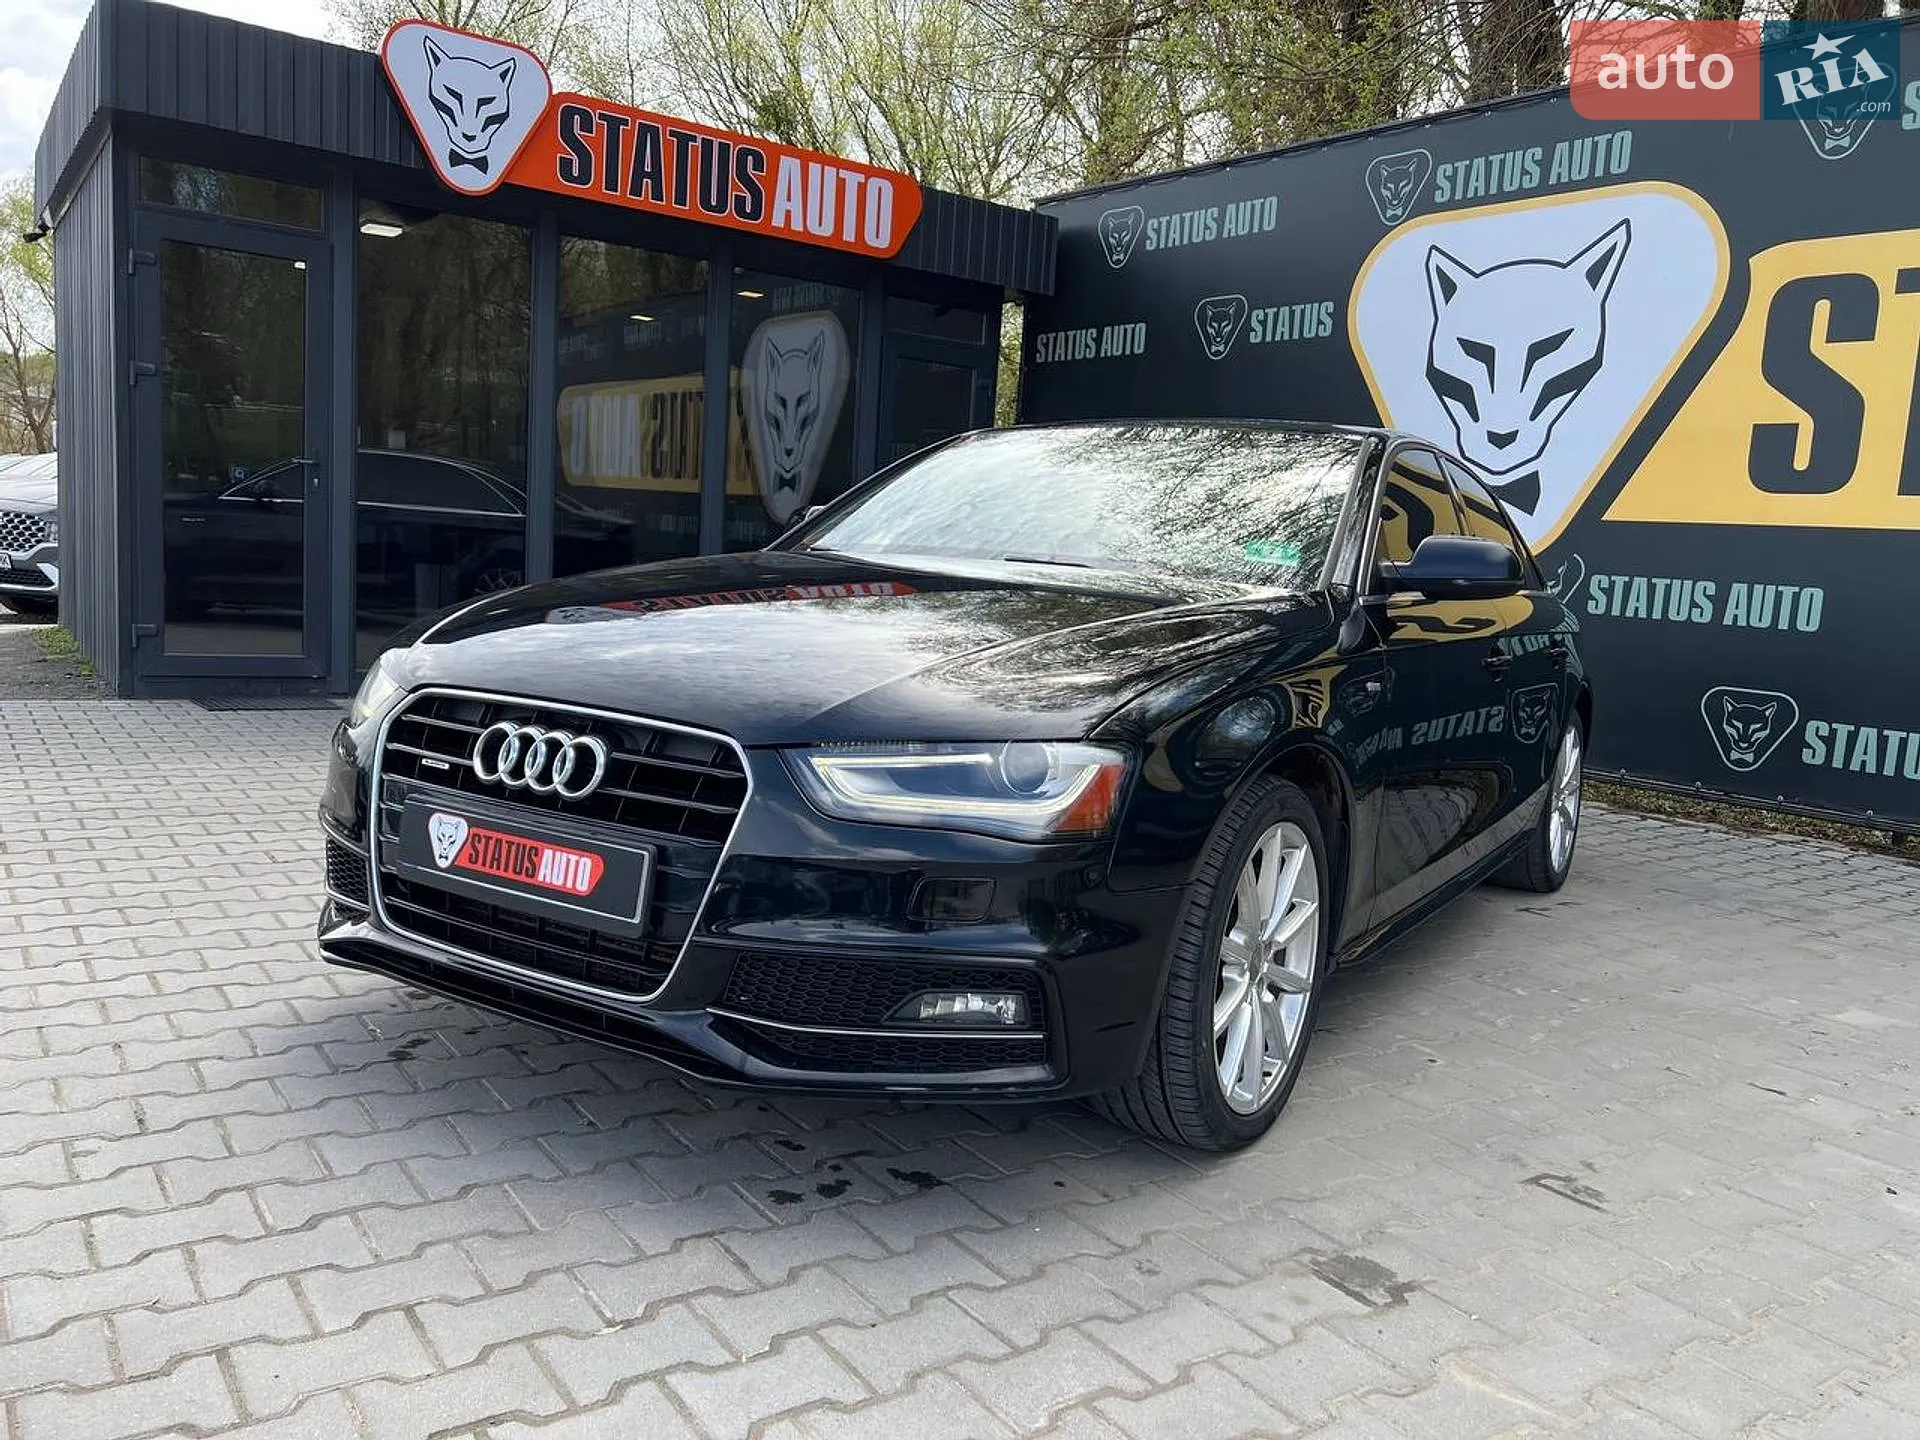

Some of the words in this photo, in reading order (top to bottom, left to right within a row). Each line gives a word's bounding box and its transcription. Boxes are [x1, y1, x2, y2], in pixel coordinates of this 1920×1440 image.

[557, 104, 767, 222] STATUS
[771, 155, 894, 249] AUTO
[1435, 146, 1541, 203] STATUS
[1548, 130, 1633, 185] AUTO
[1145, 206, 1219, 250] STATUS
[1223, 196, 1278, 240] AUTO
[1036, 328, 1098, 363] STATUS
[1101, 322, 1146, 358] AUTO
[1249, 301, 1335, 343] STATUS
[1749, 268, 1920, 495] S
[1587, 574, 1714, 623] STATUS
[1723, 583, 1824, 632] AUTO
[468, 834, 539, 878] STATUS
[538, 848, 593, 892] AUTO
